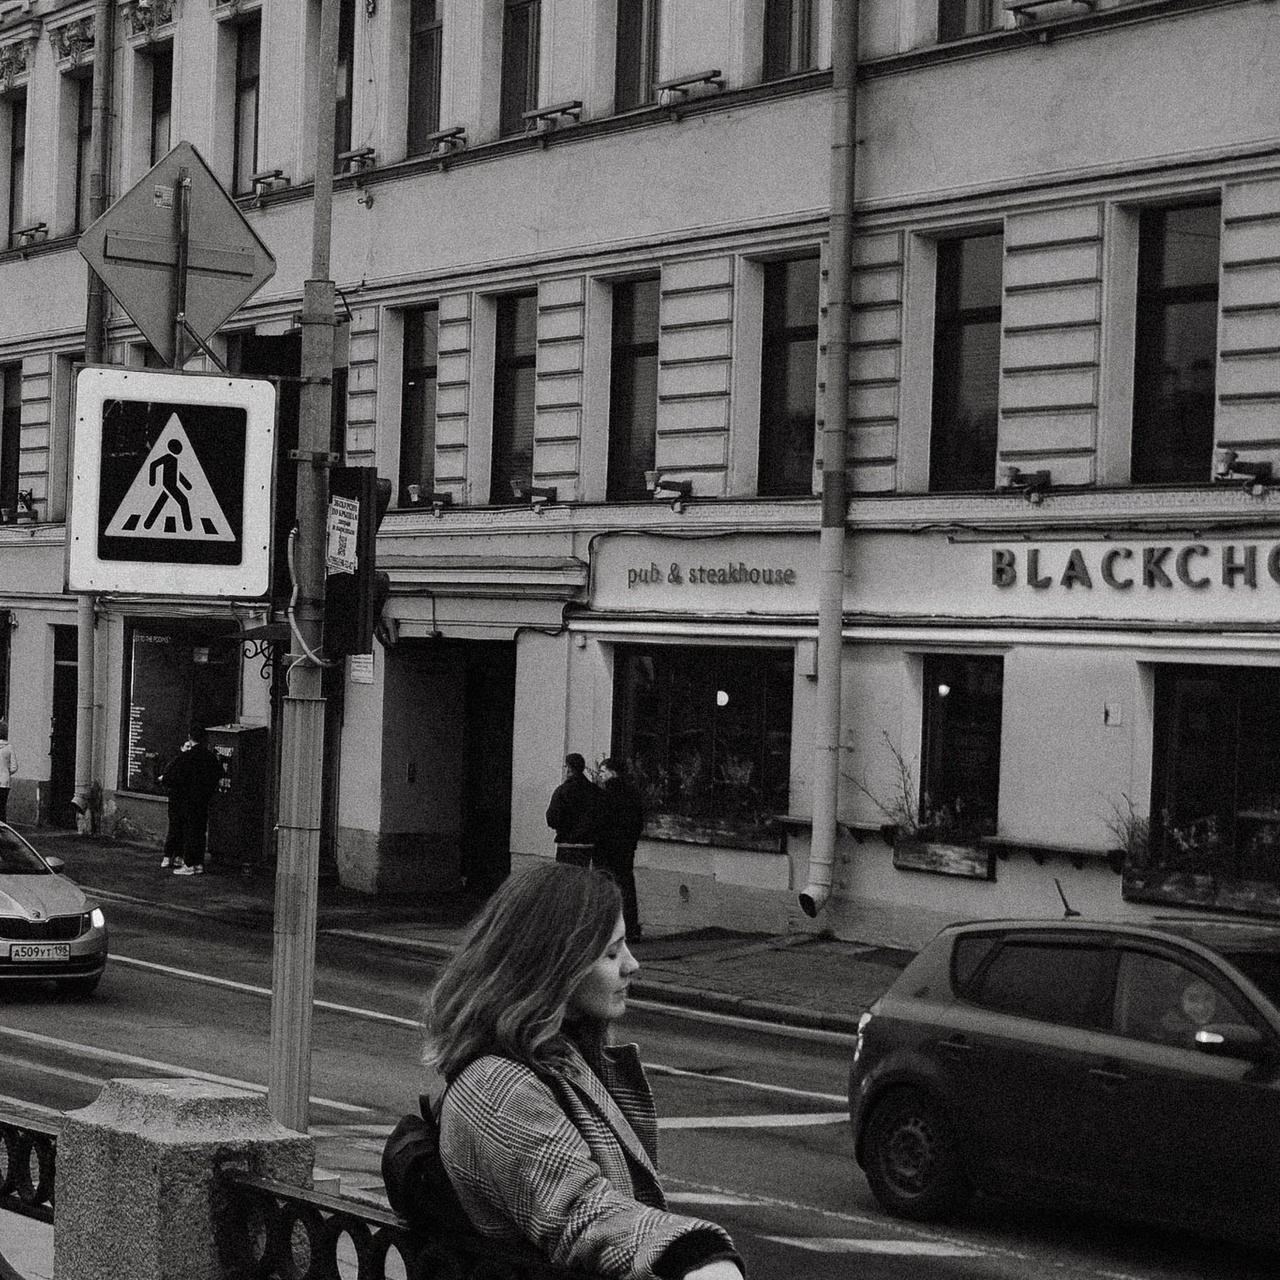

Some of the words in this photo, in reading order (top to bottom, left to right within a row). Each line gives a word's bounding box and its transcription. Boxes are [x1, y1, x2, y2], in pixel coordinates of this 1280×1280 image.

[627, 562, 661, 589] pub
[667, 562, 683, 585] &
[688, 561, 797, 586] steakhouse
[991, 544, 1280, 591] BLACKCH
